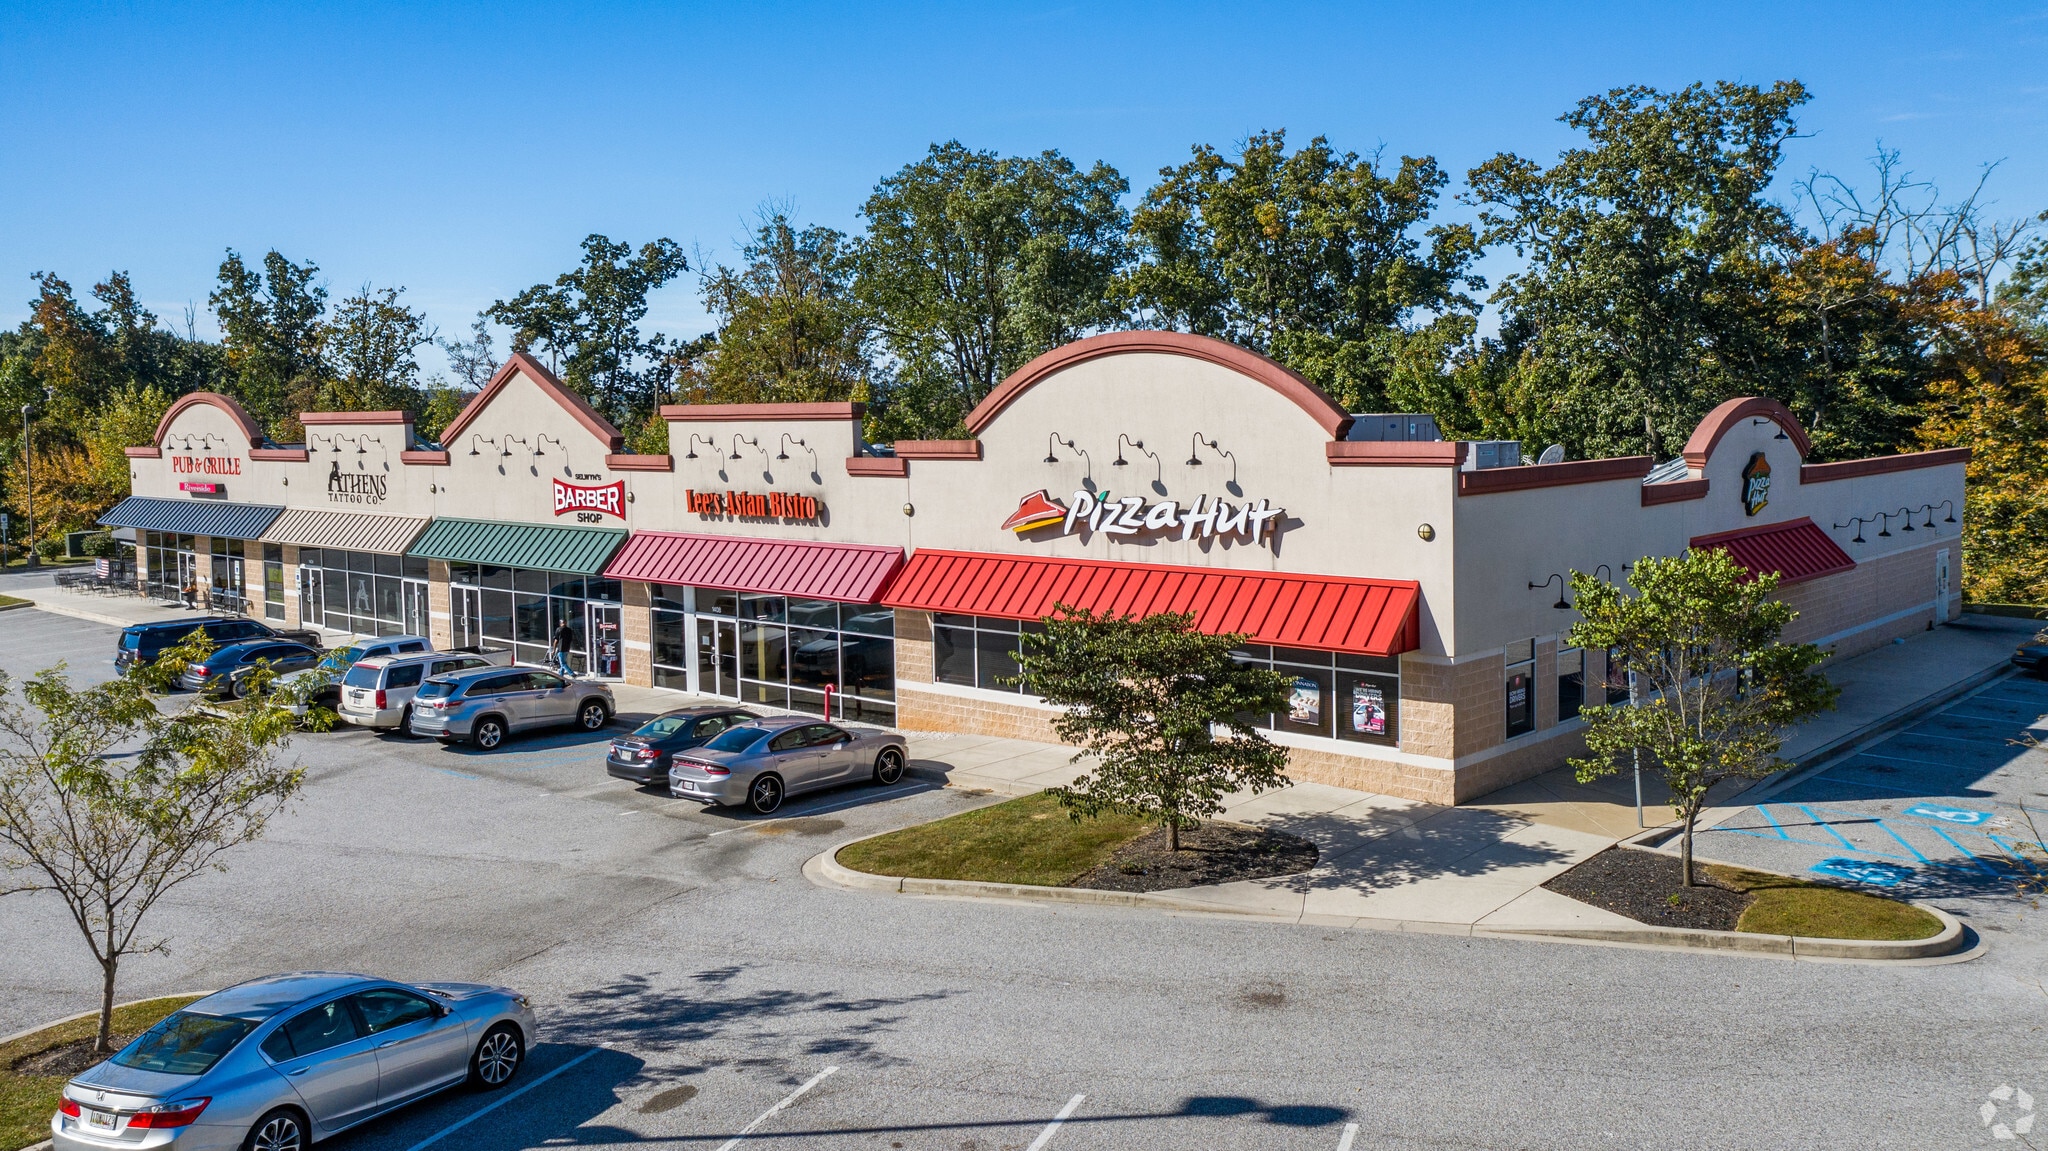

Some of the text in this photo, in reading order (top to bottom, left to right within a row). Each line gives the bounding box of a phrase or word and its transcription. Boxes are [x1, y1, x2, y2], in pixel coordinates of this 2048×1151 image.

[172, 456, 241, 475] PUB & GRILLE
[328, 461, 387, 500] ATHENS
[328, 493, 381, 505] TATTOO CO.
[554, 483, 620, 514] BARBER
[685, 489, 816, 519] Lee's Asian Bistro
[577, 512, 602, 523] SHOP
[1064, 490, 1284, 545] Pizza Hut
